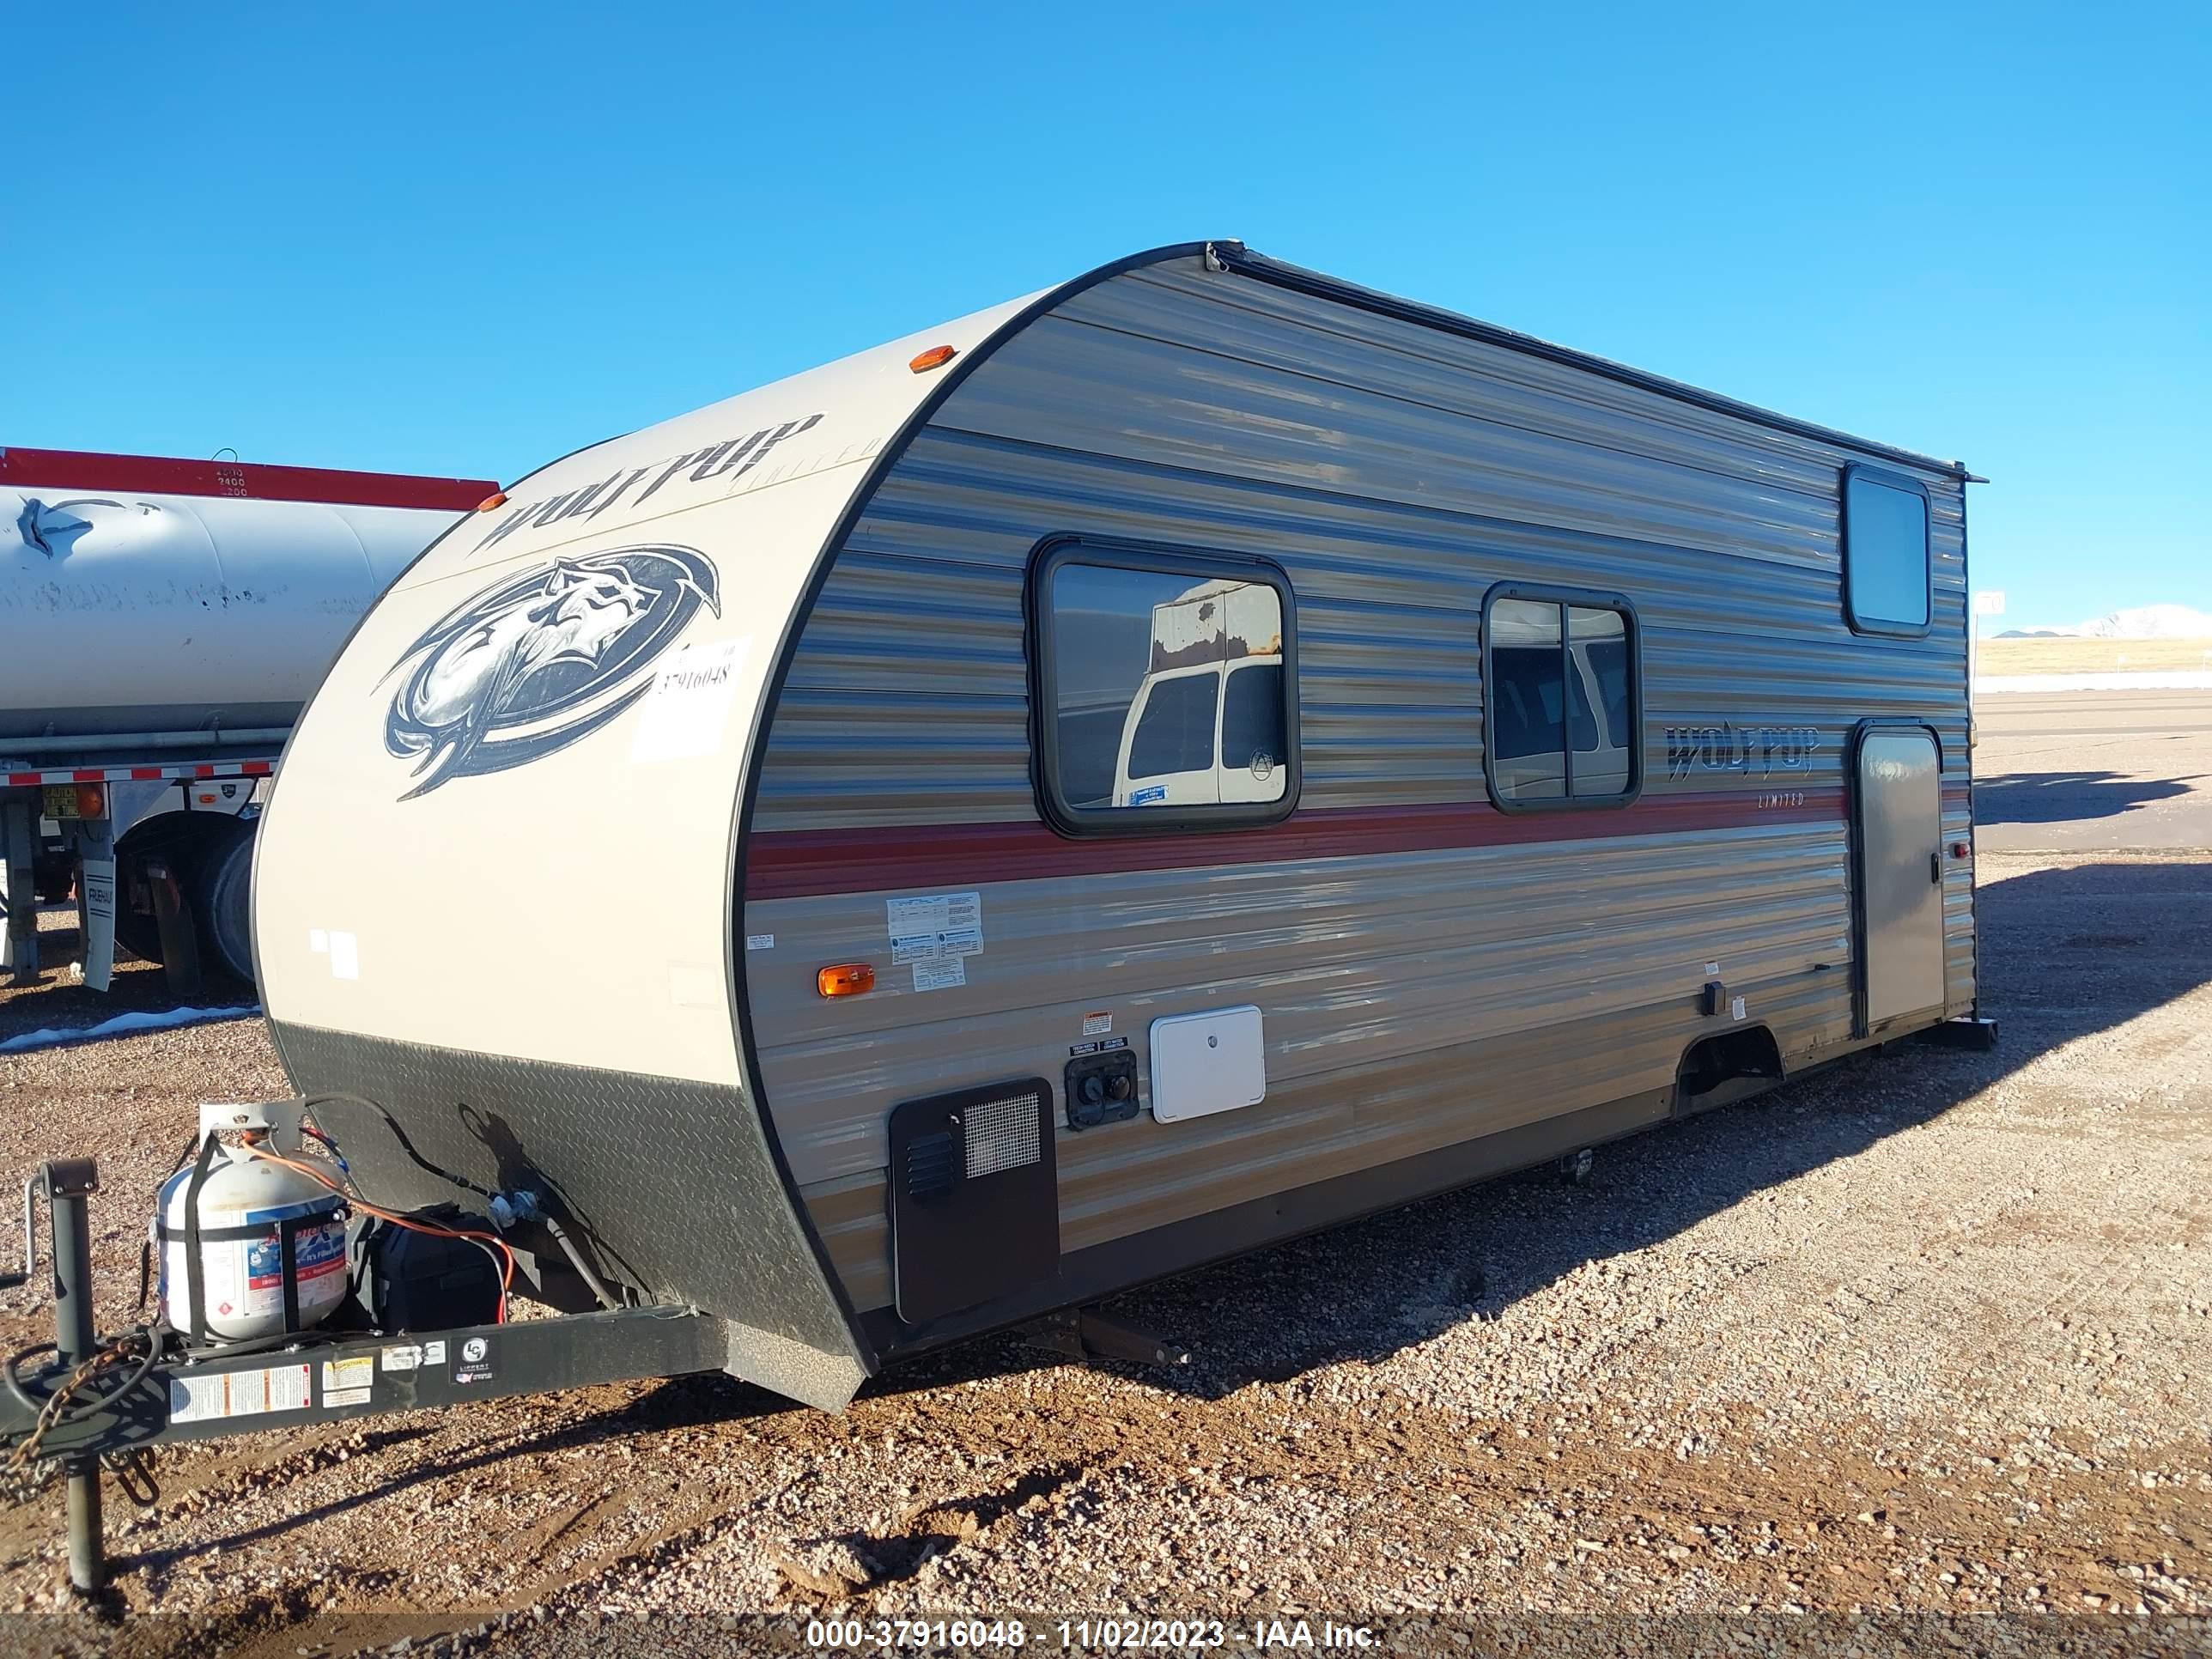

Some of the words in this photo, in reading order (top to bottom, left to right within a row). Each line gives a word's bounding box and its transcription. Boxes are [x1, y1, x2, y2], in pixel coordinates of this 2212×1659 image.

[726, 437, 882, 496] LIMITED
[217, 477, 246, 487] 2400
[1758, 793, 1804, 809] LIMITED
